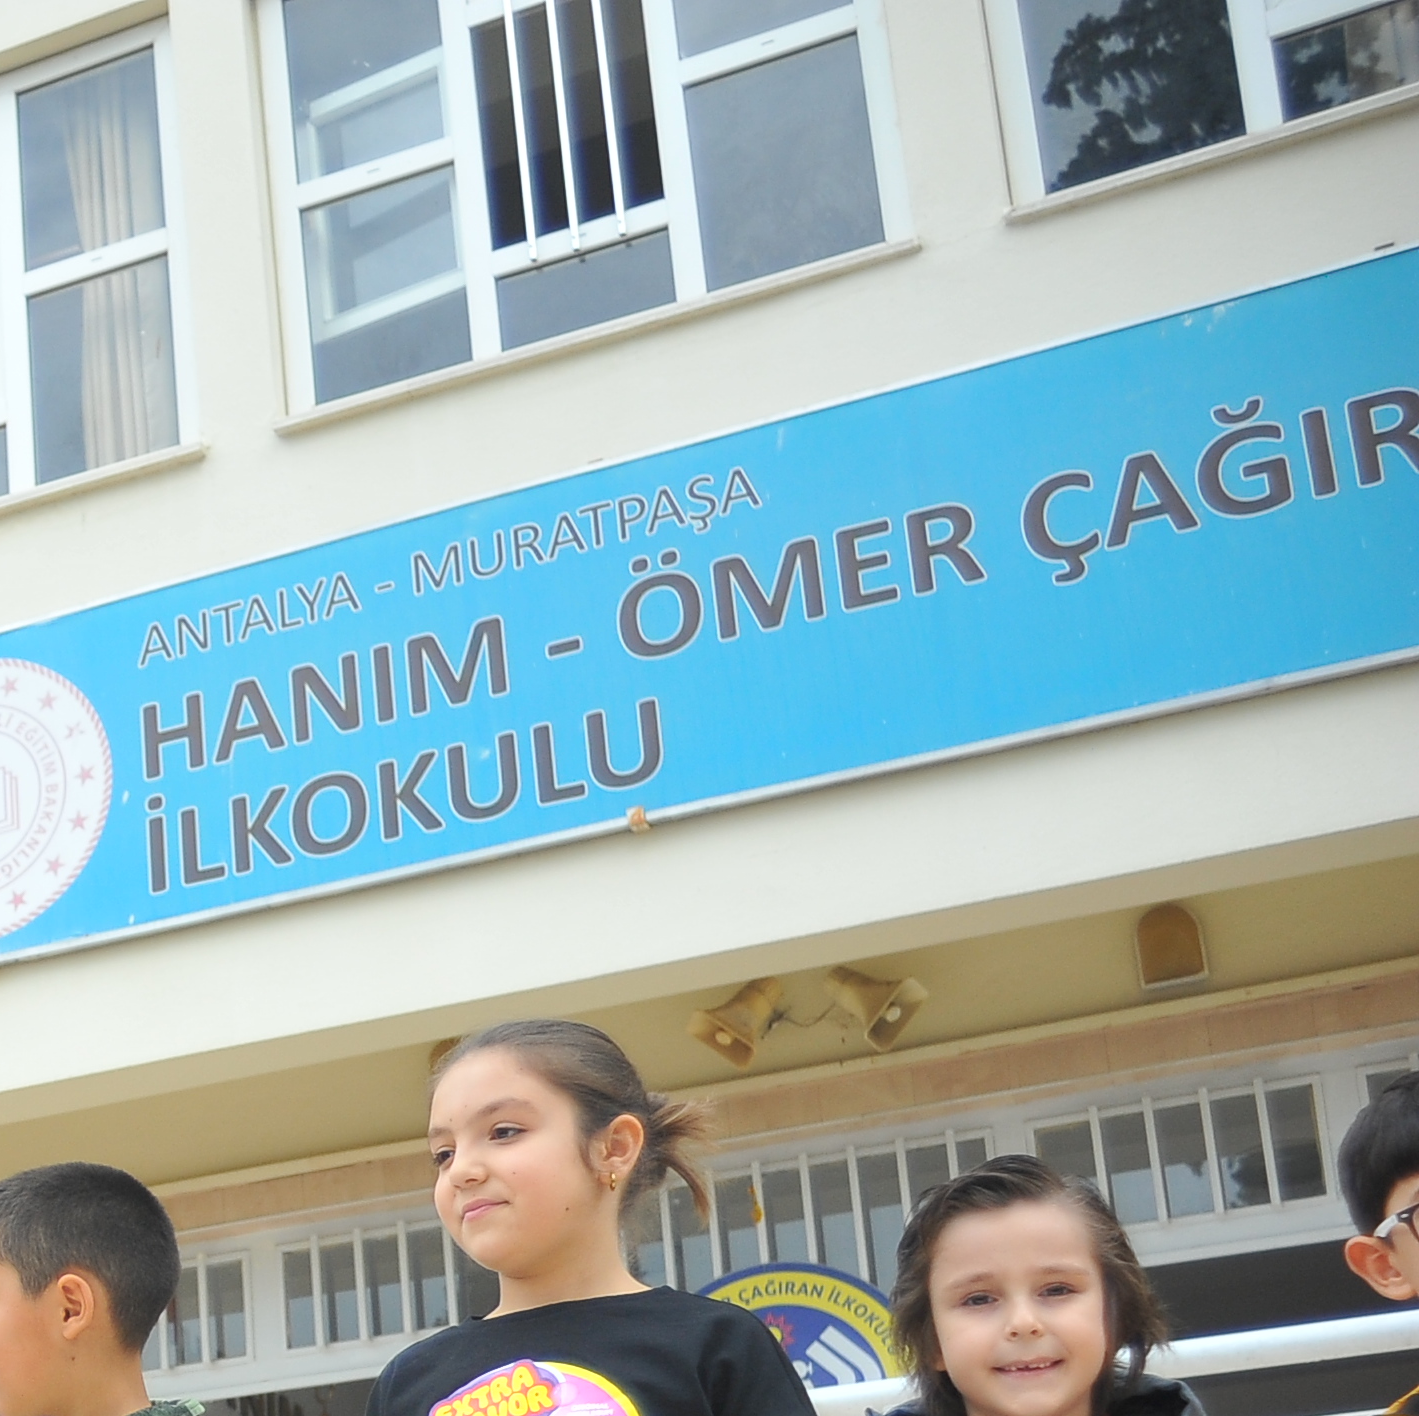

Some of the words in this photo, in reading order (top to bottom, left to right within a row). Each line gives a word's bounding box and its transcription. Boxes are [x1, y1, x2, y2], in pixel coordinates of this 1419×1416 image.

[139, 573, 361, 667] ANTALYA
[410, 467, 761, 596] MURATPAŞA
[140, 616, 509, 780] HANIM
[546, 636, 583, 659] -
[617, 503, 987, 660] ÖMER
[15, 721, 58, 783] EĞİTİM
[144, 696, 663, 895] İLKOKULU
[738, 1280, 824, 1305] ÇAĞIRAN
